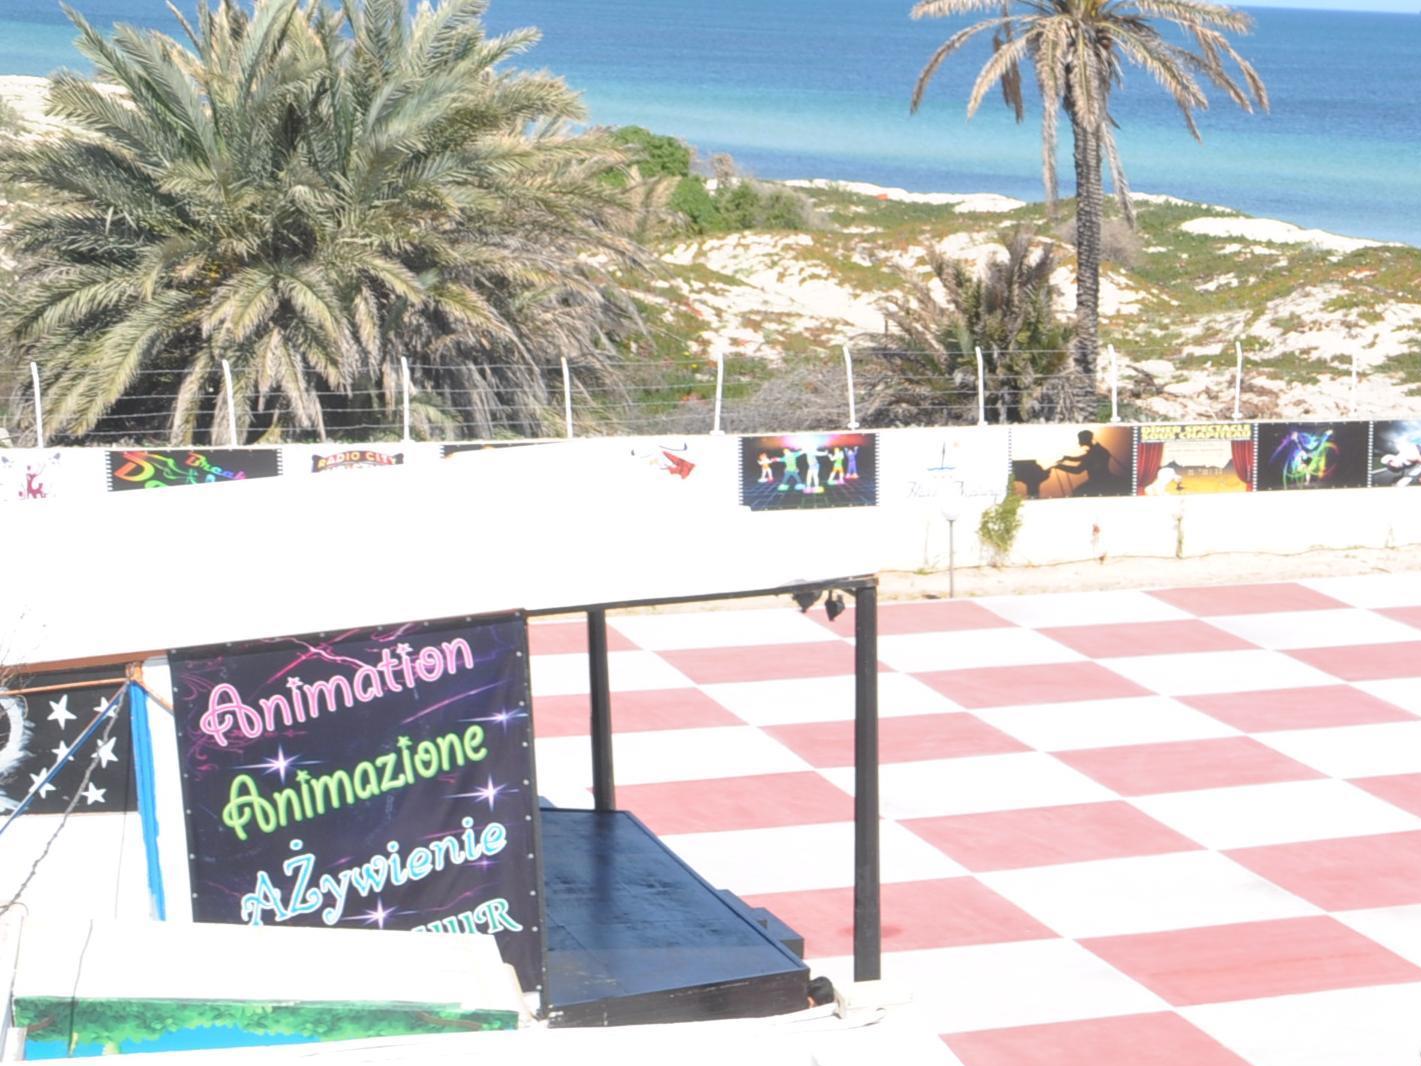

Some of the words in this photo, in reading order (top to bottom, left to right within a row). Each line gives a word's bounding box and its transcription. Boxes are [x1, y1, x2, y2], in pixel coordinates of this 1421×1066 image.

[317, 451, 361, 469] RADIO
[365, 451, 397, 465] CITY
[1184, 423, 1251, 433] SPECTACLE
[200, 637, 474, 747] Animation
[222, 724, 488, 841] Animazione
